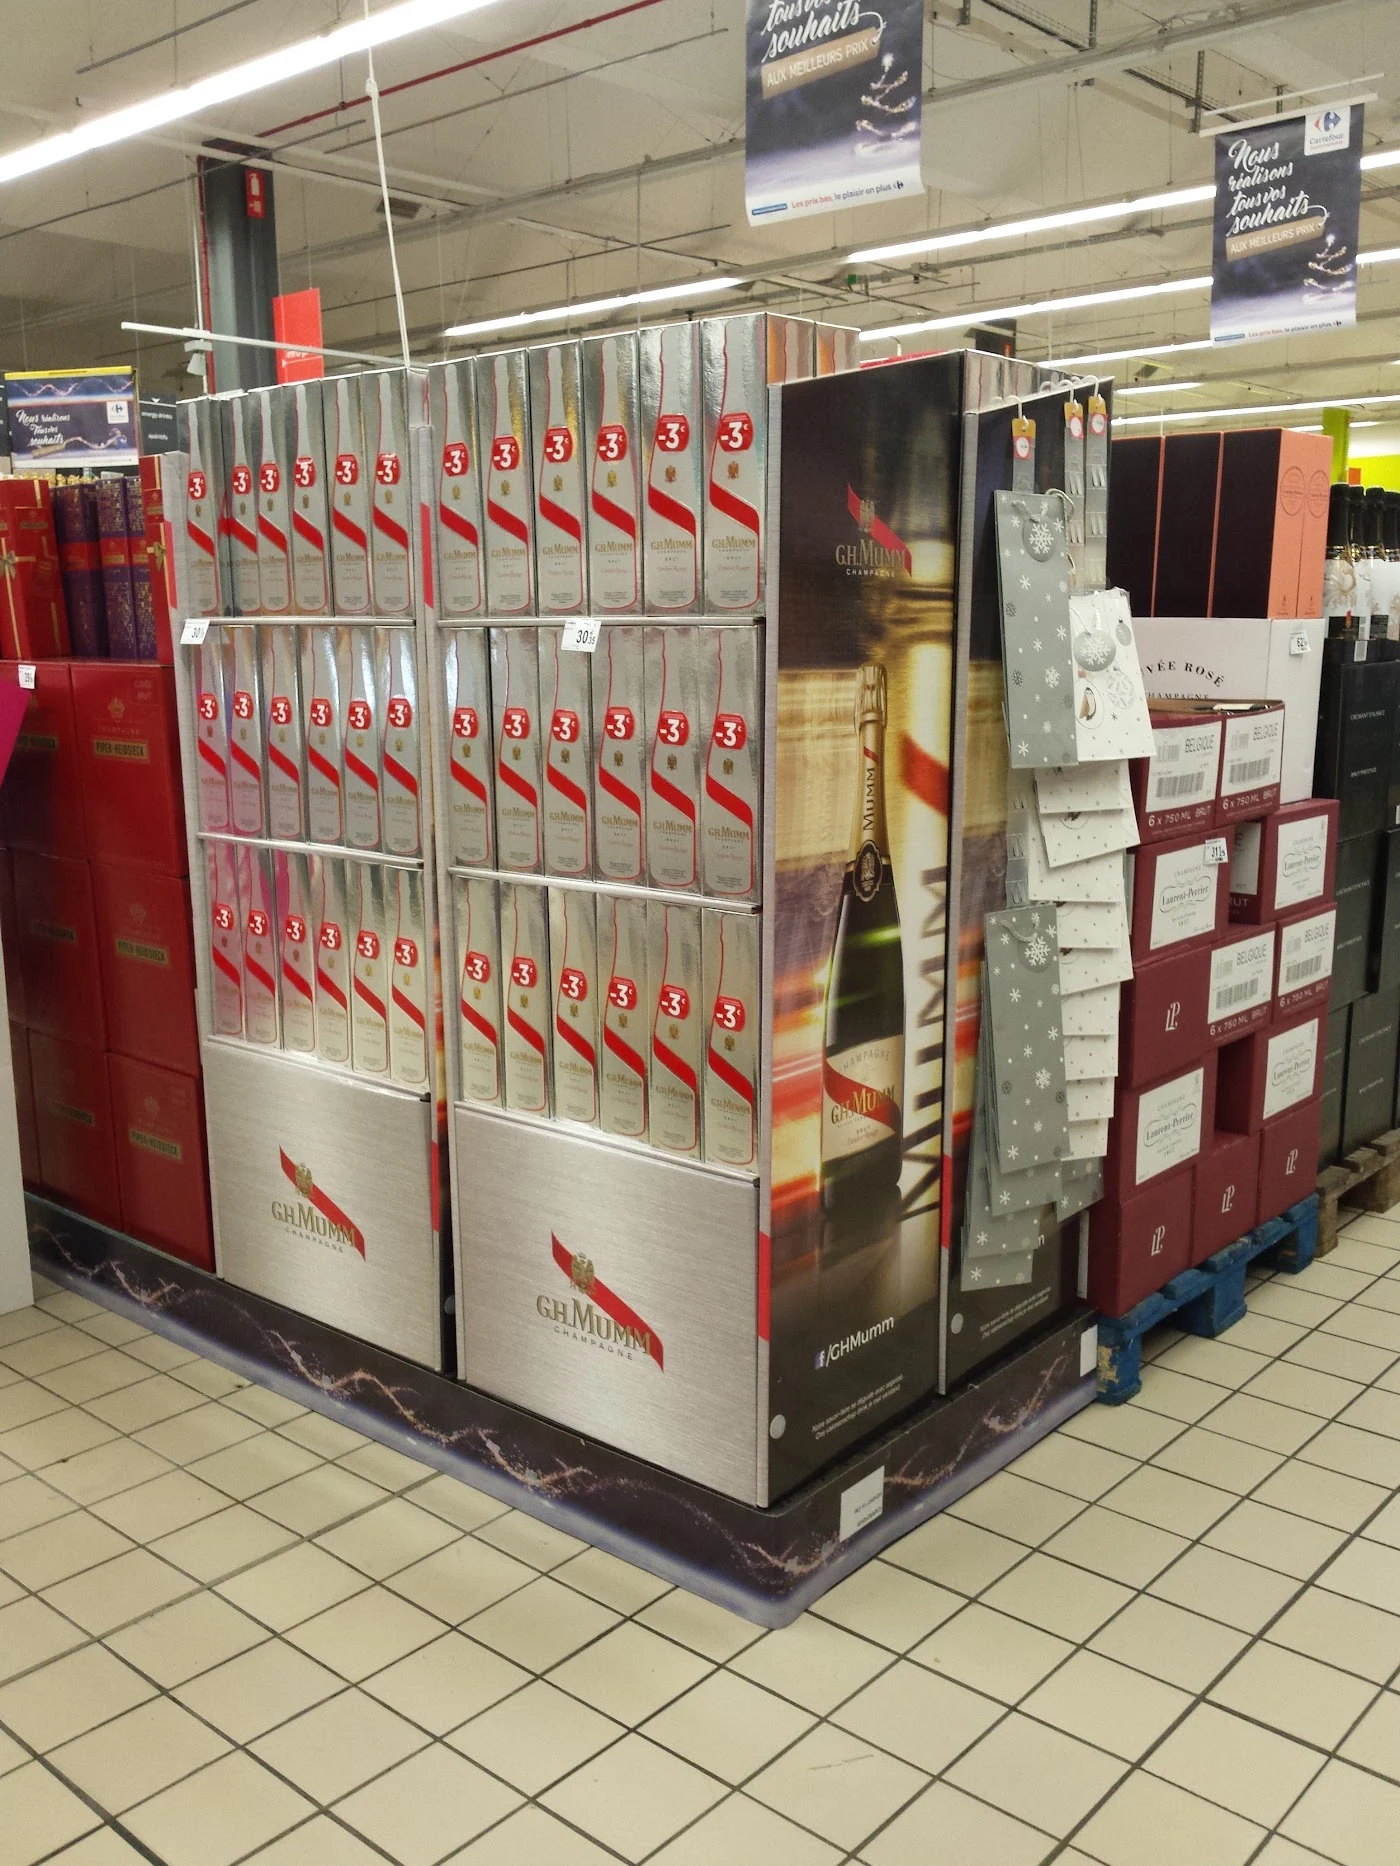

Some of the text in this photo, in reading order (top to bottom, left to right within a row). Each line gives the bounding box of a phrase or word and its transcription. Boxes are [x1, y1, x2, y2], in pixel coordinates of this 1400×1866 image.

[761, 0, 860, 63] souhaits
[766, 38, 869, 88] AUX MEILLEURS PRIX
[1309, 133, 1344, 145] Carrefour
[1228, 139, 1280, 173] Nous
[791, 201, 804, 209] Les
[805, 198, 819, 208] prix
[842, 187, 864, 200] plaisir
[865, 186, 875, 195] en
[875, 183, 892, 193] plus
[1226, 185, 1287, 218] tous vos
[1226, 190, 1310, 237] souhaits
[1230, 223, 1315, 254] AUX MEILLEURS PRIX
[846, 568, 896, 578] CHAMPAGNE
[576, 629, 589, 644] 30
[1141, 660, 1225, 687] VÉE ROSÉ
[1184, 734, 1215, 753] BELGIQUE
[1253, 723, 1279, 741] BELGIQUE
[96, 739, 145, 756] PIPER-HEIDSIECK
[863, 767, 876, 832] MUMM
[1222, 798, 1229, 810] 6
[1236, 795, 1250, 806] 750
[1250, 794, 1260, 802] ML
[1263, 788, 1278, 800] BRUT
[1148, 815, 1155, 827] 6
[1165, 812, 1180, 824] 750
[1181, 811, 1191, 820] ML
[1195, 805, 1212, 818] BRUT
[1162, 885, 1209, 906] Laurent-Perrier
[1304, 922, 1330, 943] BELGIQUE
[1236, 944, 1267, 966] BELGIQUE
[1279, 997, 1285, 1008] 6
[1292, 992, 1303, 1003] 750
[1315, 981, 1329, 993] BRUT
[1210, 1025, 1216, 1036] 6
[1224, 1019, 1238, 1031] 750
[1238, 1016, 1248, 1025] ML
[1252, 1006, 1267, 1020] BRUT
[1273, 1058, 1310, 1081] Laurent-Perrier
[1146, 1112, 1194, 1141] Laurent-Perrier
[286, 1227, 344, 1253] CHAMPAGNE
[554, 1326, 633, 1361] CHAMPAGNE
